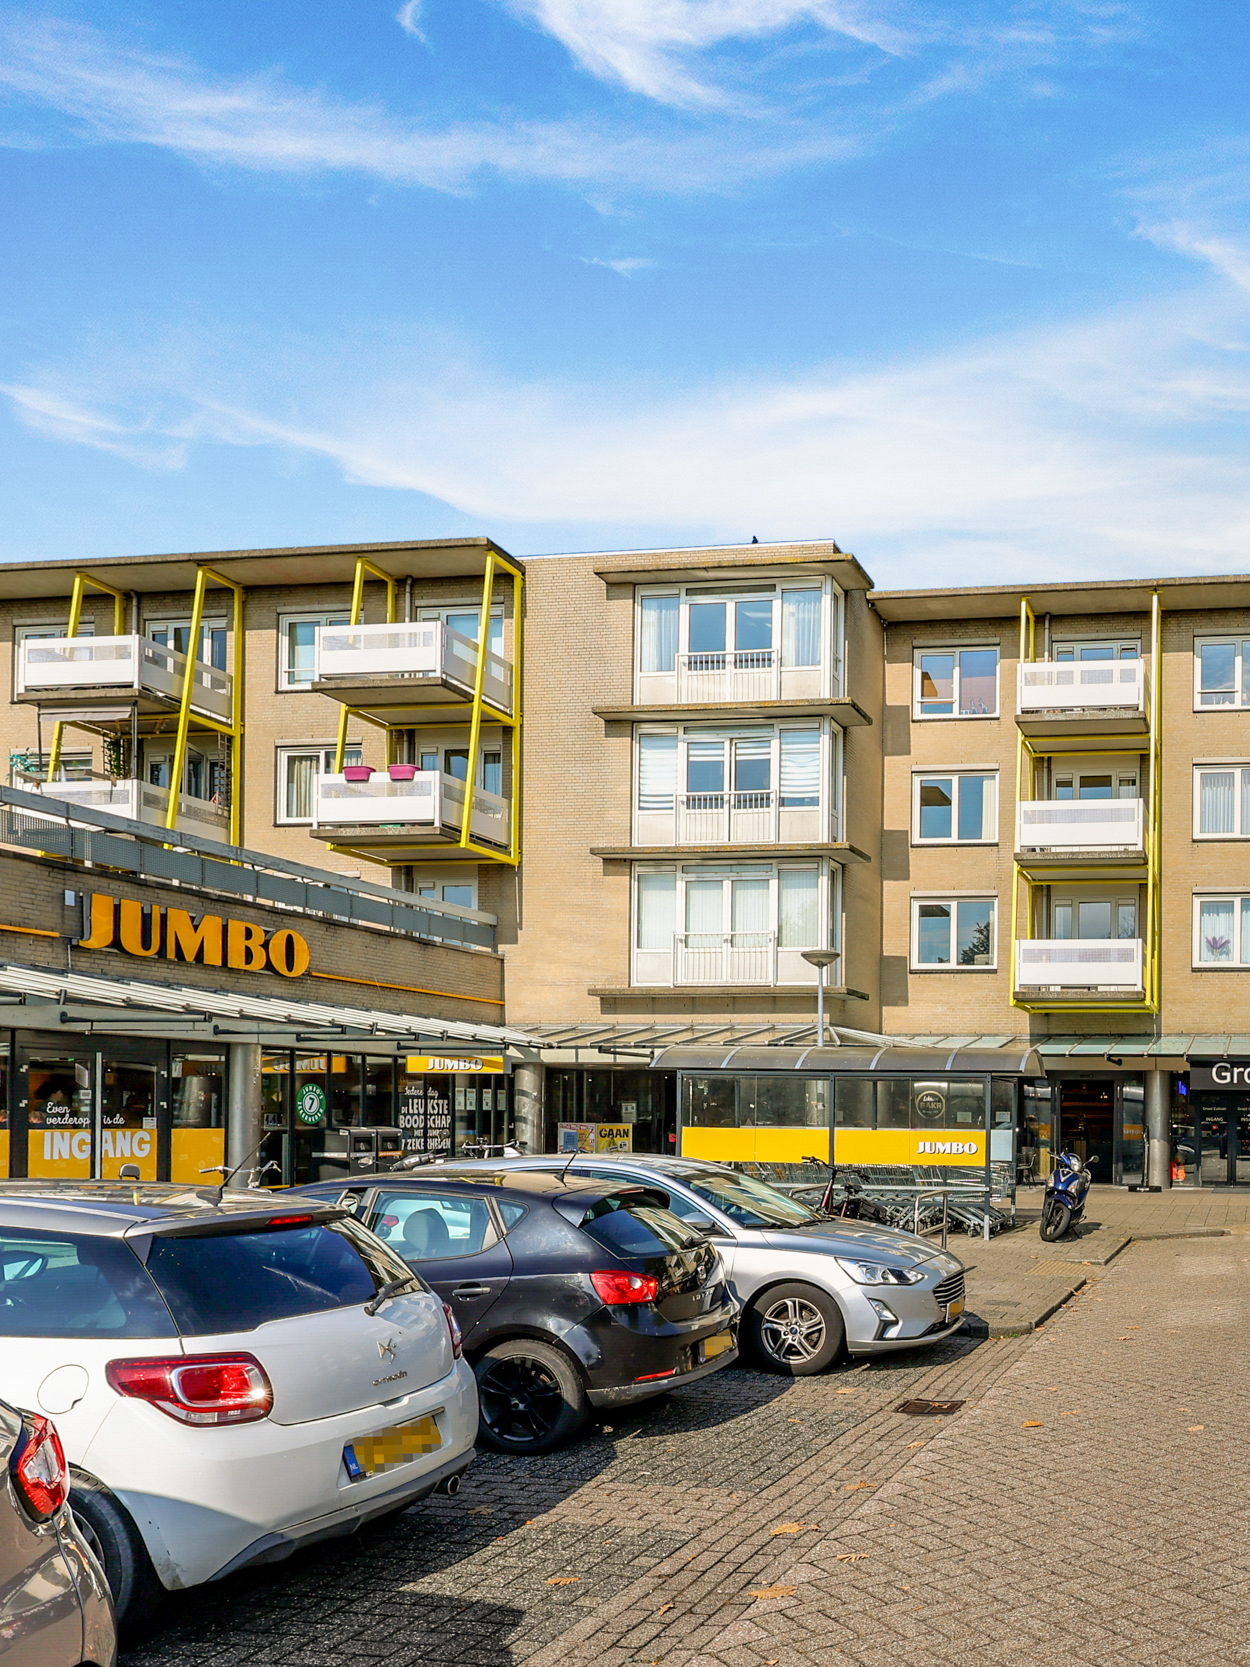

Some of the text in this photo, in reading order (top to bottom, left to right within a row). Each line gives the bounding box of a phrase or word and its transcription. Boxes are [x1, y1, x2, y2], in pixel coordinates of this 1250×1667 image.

[79, 893, 310, 977] JUMBO
[427, 1058, 483, 1070] JUMBO
[46, 1101, 71, 1114] Even
[308, 1096, 316, 1111] 7
[46, 1113, 125, 1128] verderop is de
[599, 1128, 629, 1138] GAAN
[916, 1141, 978, 1155] JUMBO
